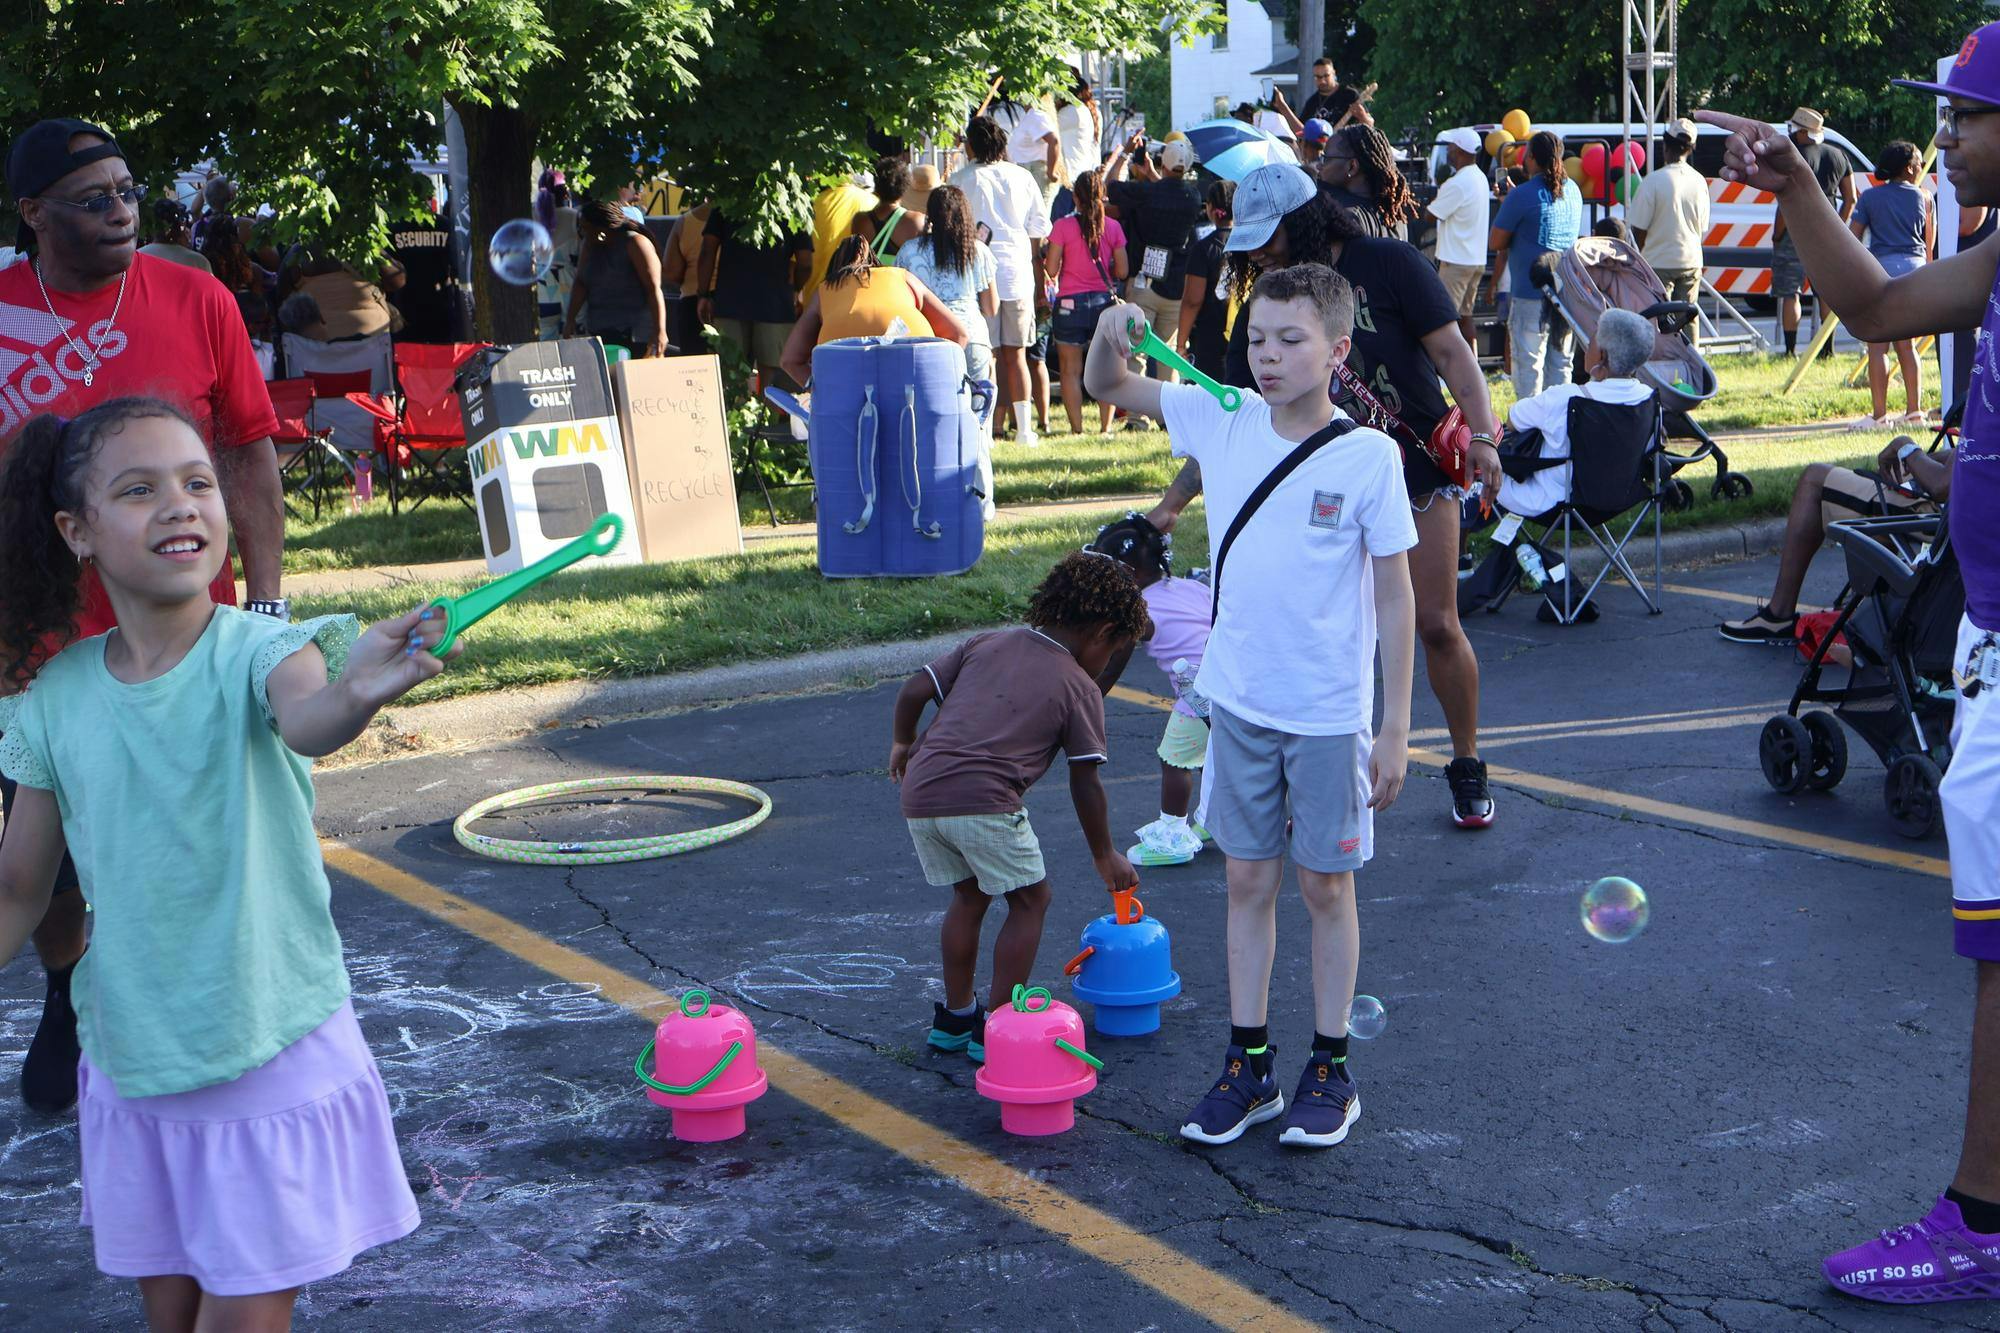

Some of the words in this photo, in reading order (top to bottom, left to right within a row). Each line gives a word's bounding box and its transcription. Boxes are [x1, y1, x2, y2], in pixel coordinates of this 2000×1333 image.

[394, 231, 449, 249] SECURITY
[519, 366, 576, 385] TRASH
[529, 391, 572, 408] ONLY
[631, 396, 703, 417] RECYCLE
[470, 406, 485, 427] ONLY
[508, 423, 608, 460] WM
[470, 438, 502, 479] WM
[644, 472, 725, 505] RECYCLE
[1882, 1265, 1906, 1279] SO
[1911, 1262, 1934, 1277] SO
